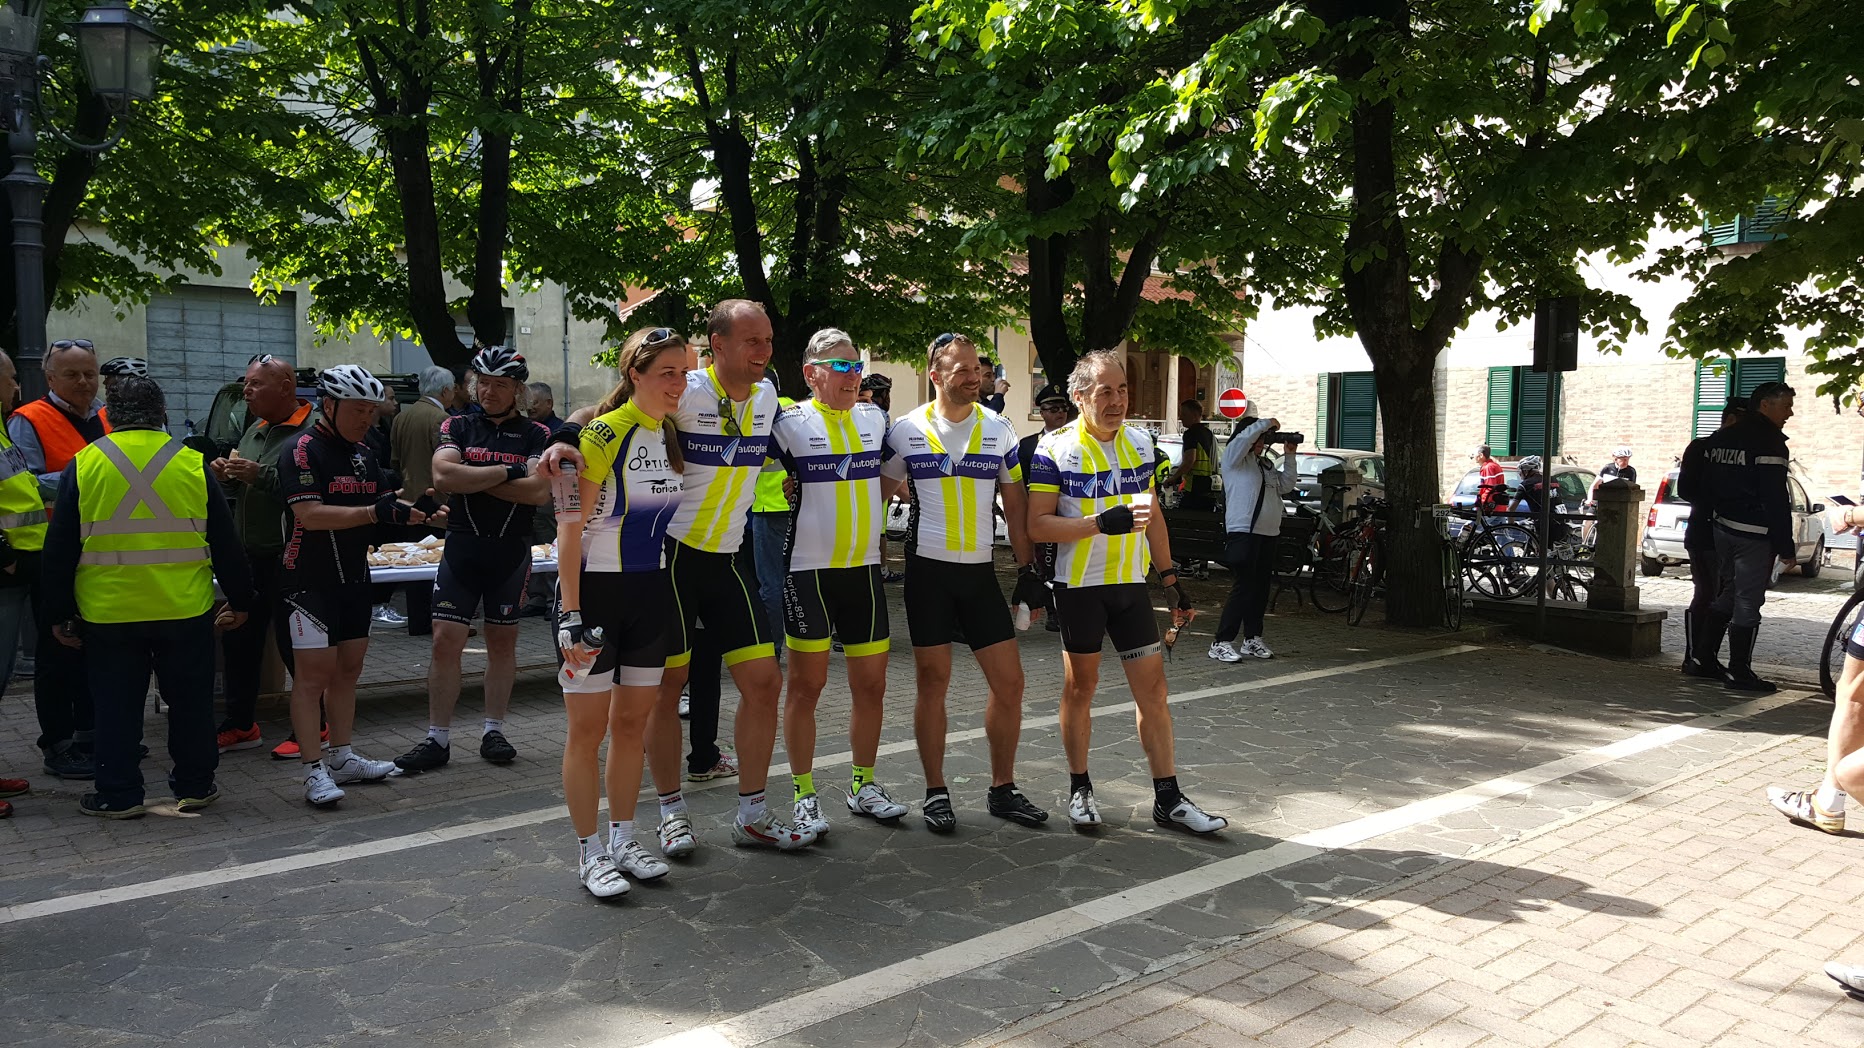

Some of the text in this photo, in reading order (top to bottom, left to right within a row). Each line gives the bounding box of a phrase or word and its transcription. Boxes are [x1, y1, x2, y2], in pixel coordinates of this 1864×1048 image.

[687, 440, 767, 455] braun autoglas
[808, 457, 880, 471] braun autoglas
[1711, 448, 1746, 466] POLIZIA
[911, 461, 999, 471] braun autoglas
[651, 484, 678, 494] forice
[783, 587, 795, 622] dachau
[786, 574, 808, 634] forice-89.de
